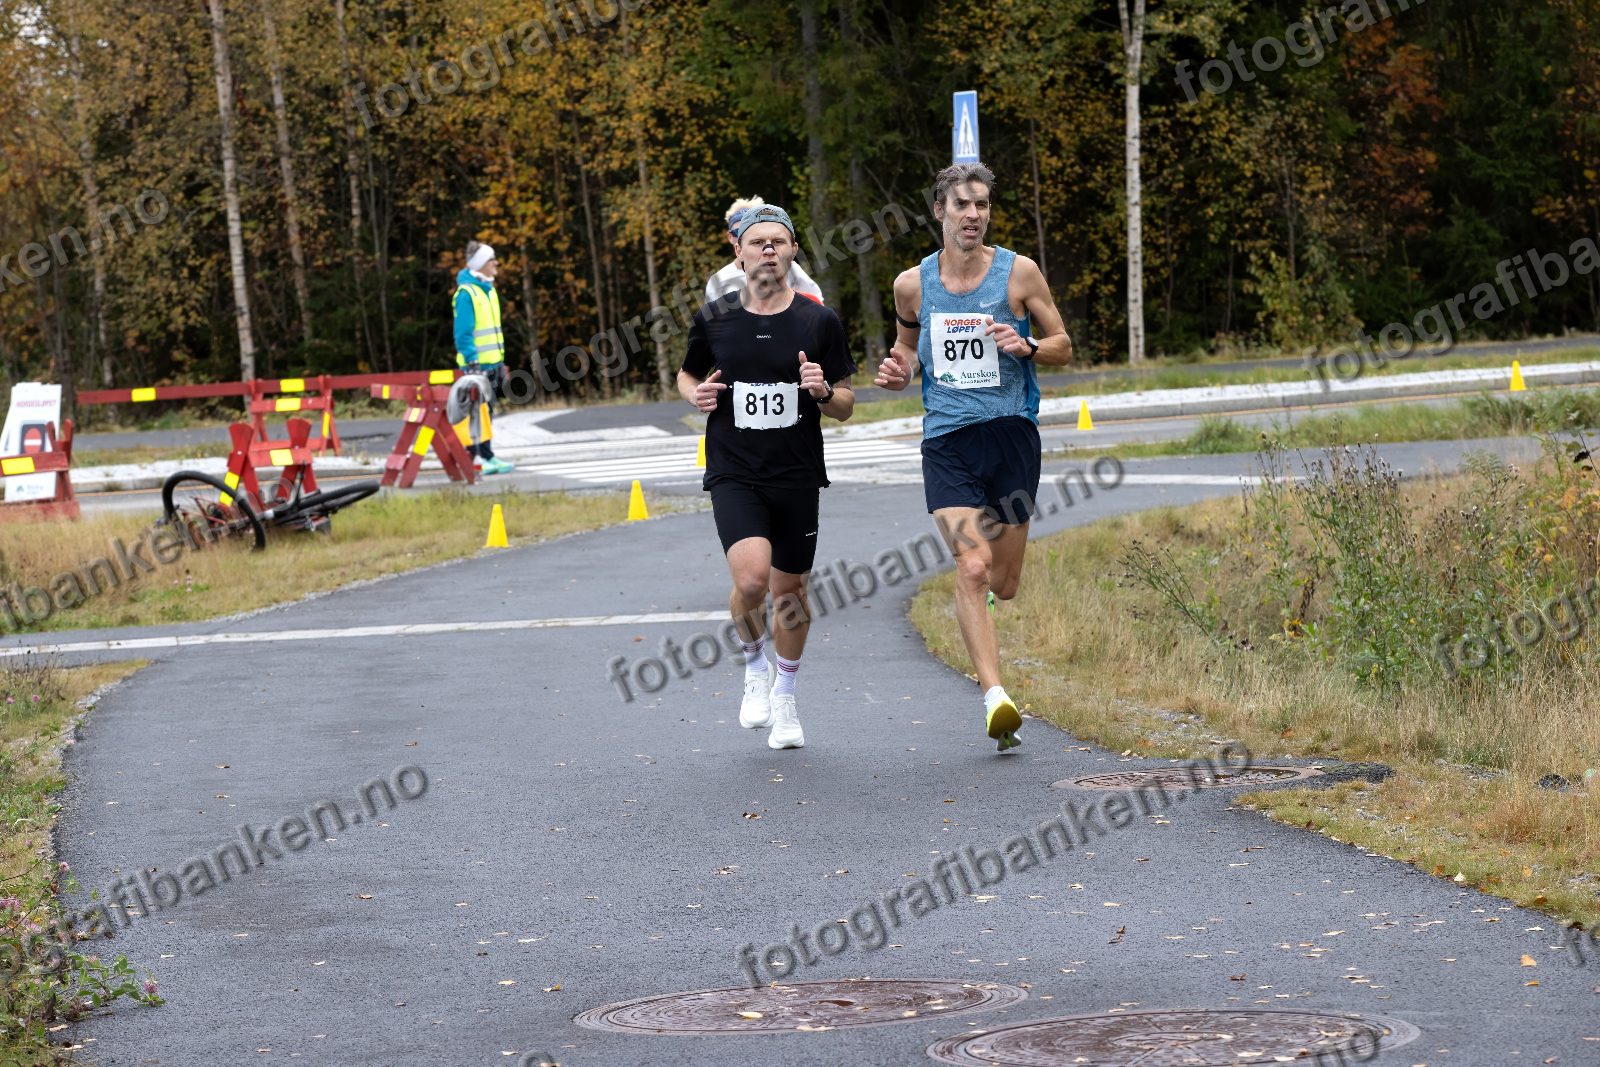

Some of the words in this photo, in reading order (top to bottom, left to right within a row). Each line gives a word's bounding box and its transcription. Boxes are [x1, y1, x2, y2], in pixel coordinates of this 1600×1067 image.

[944, 318, 982, 327] NORGES
[946, 326, 977, 334] LØPET
[943, 338, 984, 361] 870
[960, 369, 998, 380] Aurskog
[745, 392, 785, 416] 813
